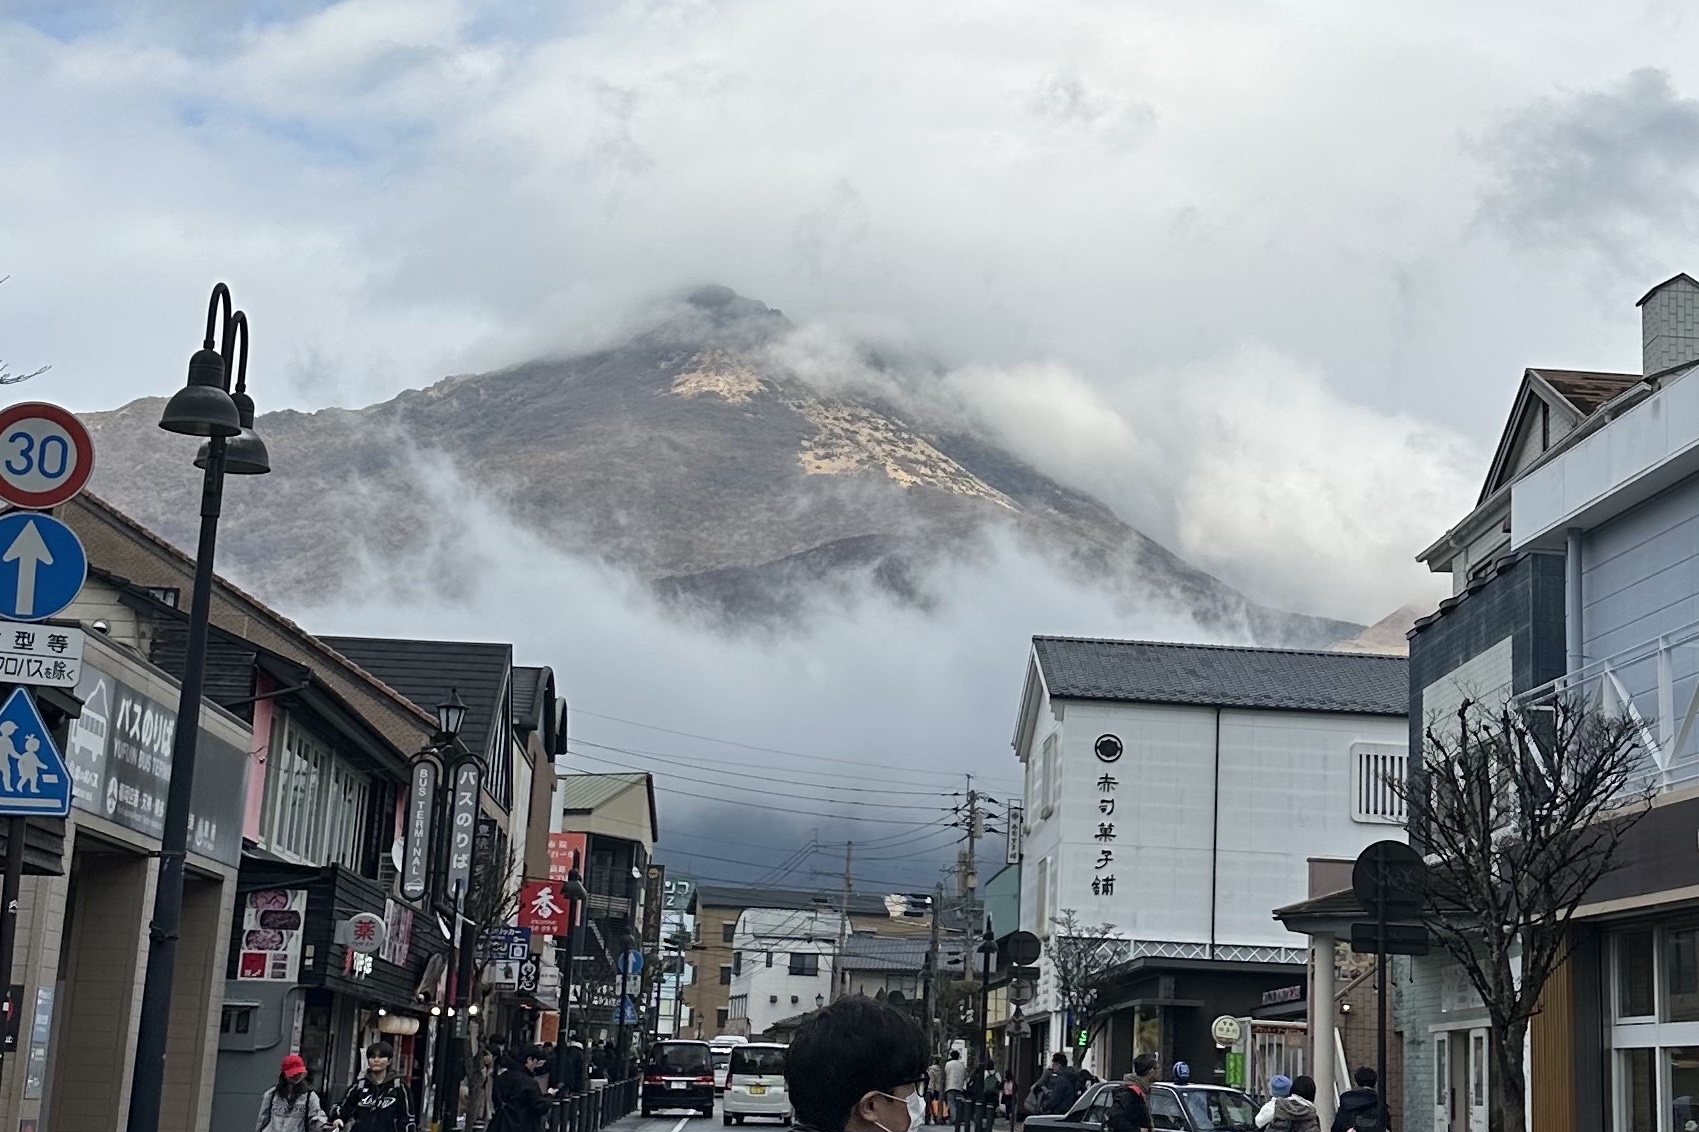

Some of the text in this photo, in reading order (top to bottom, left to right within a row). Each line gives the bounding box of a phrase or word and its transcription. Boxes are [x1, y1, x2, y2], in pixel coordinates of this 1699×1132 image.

[5, 432, 68, 478] 30
[0, 631, 69, 653] 型等
[116, 698, 175, 757] バスのりば
[411, 768, 428, 875] BUS TERMINAL
[452, 771, 477, 869] バスのりば
[1091, 773, 1119, 896] 赤司菓子舗
